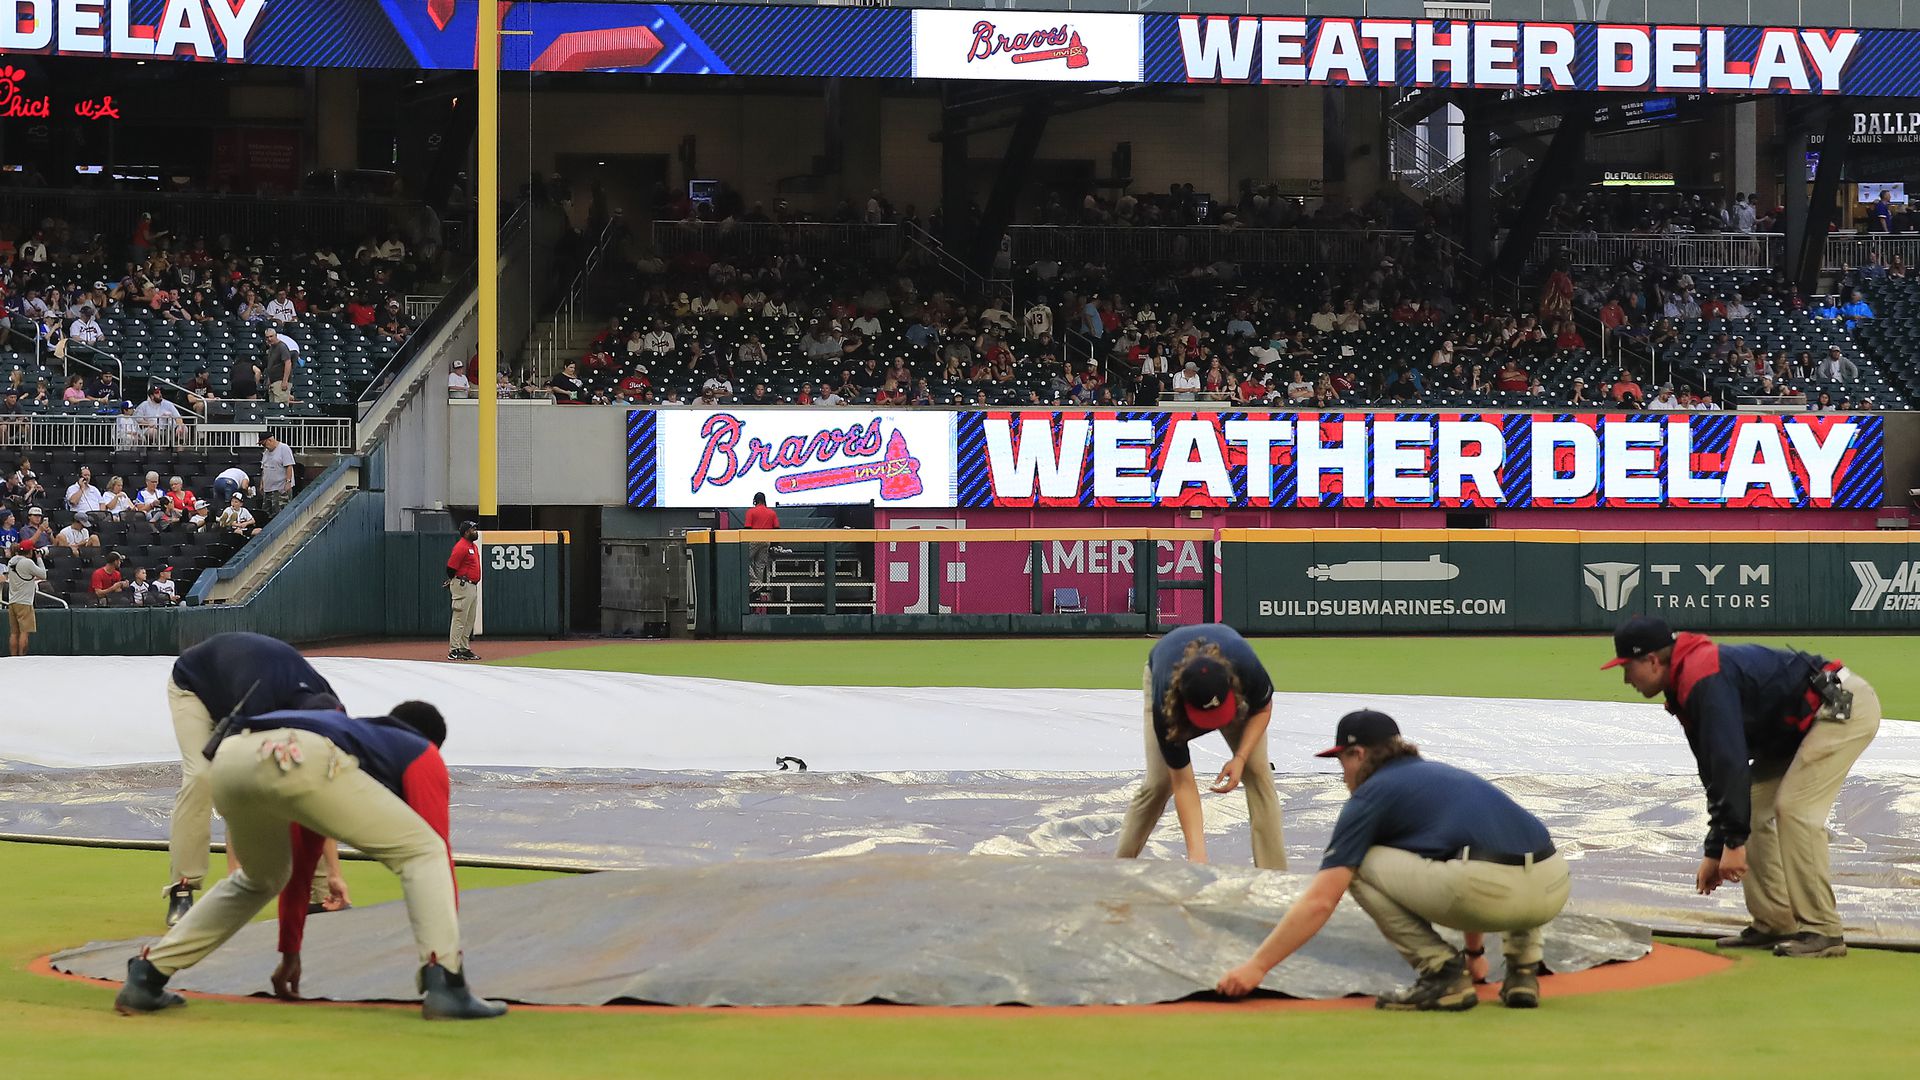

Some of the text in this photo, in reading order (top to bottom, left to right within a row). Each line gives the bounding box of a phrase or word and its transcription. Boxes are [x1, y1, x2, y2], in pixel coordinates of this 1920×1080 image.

[0, 0, 266, 59] DELAY
[967, 20, 1068, 63] Braves
[1177, 17, 1861, 91] WEATHER DELAY
[1032, 313, 1043, 325] 13
[690, 412, 883, 495] Braves
[982, 418, 1862, 503] WEATHER DELAY
[491, 545, 535, 570] 335
[1650, 564, 1770, 586] TYM
[1259, 599, 1506, 616] BUILDSUBMARINES.COM
[1653, 594, 1770, 608] TRACTORS
